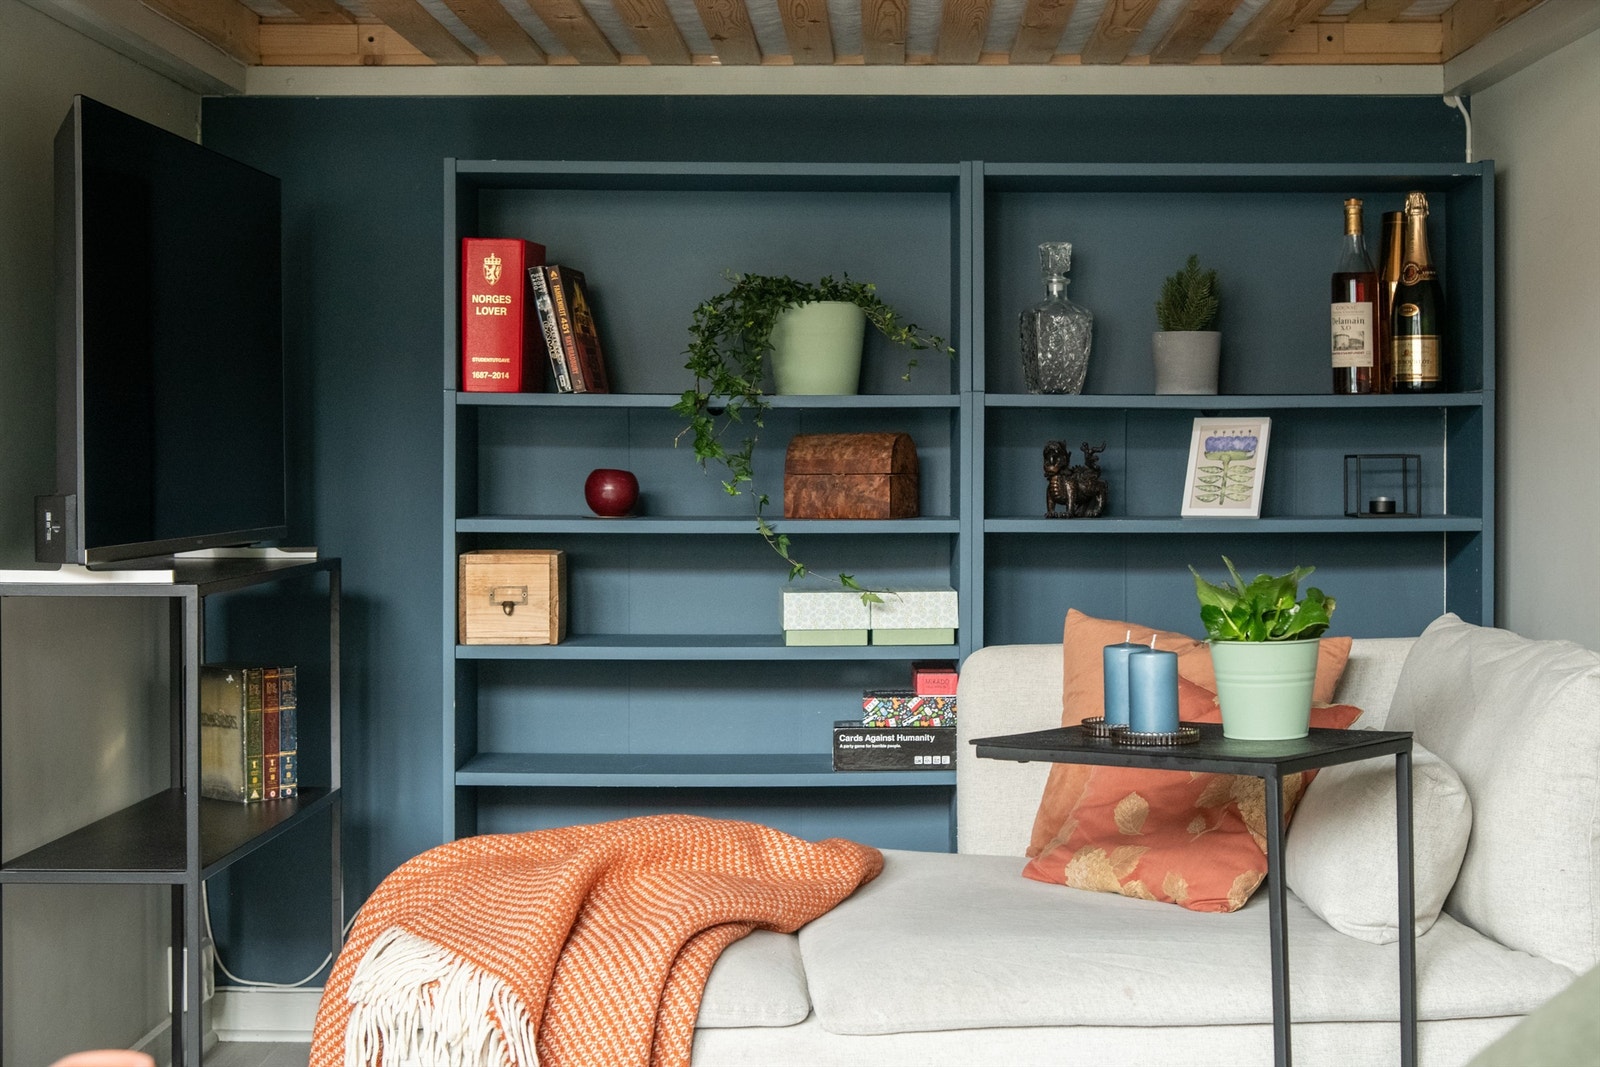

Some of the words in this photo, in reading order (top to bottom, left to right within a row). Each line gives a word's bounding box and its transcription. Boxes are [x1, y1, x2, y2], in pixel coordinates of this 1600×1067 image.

[471, 294, 512, 304] NORGES
[475, 306, 507, 316] LOVER
[553, 284, 567, 317] FAHRENHEIT
[561, 317, 570, 335] 451
[543, 320, 558, 360] GAME
[839, 734, 863, 742] Cards
[865, 734, 895, 743] Against
[896, 734, 935, 743] Humanity
